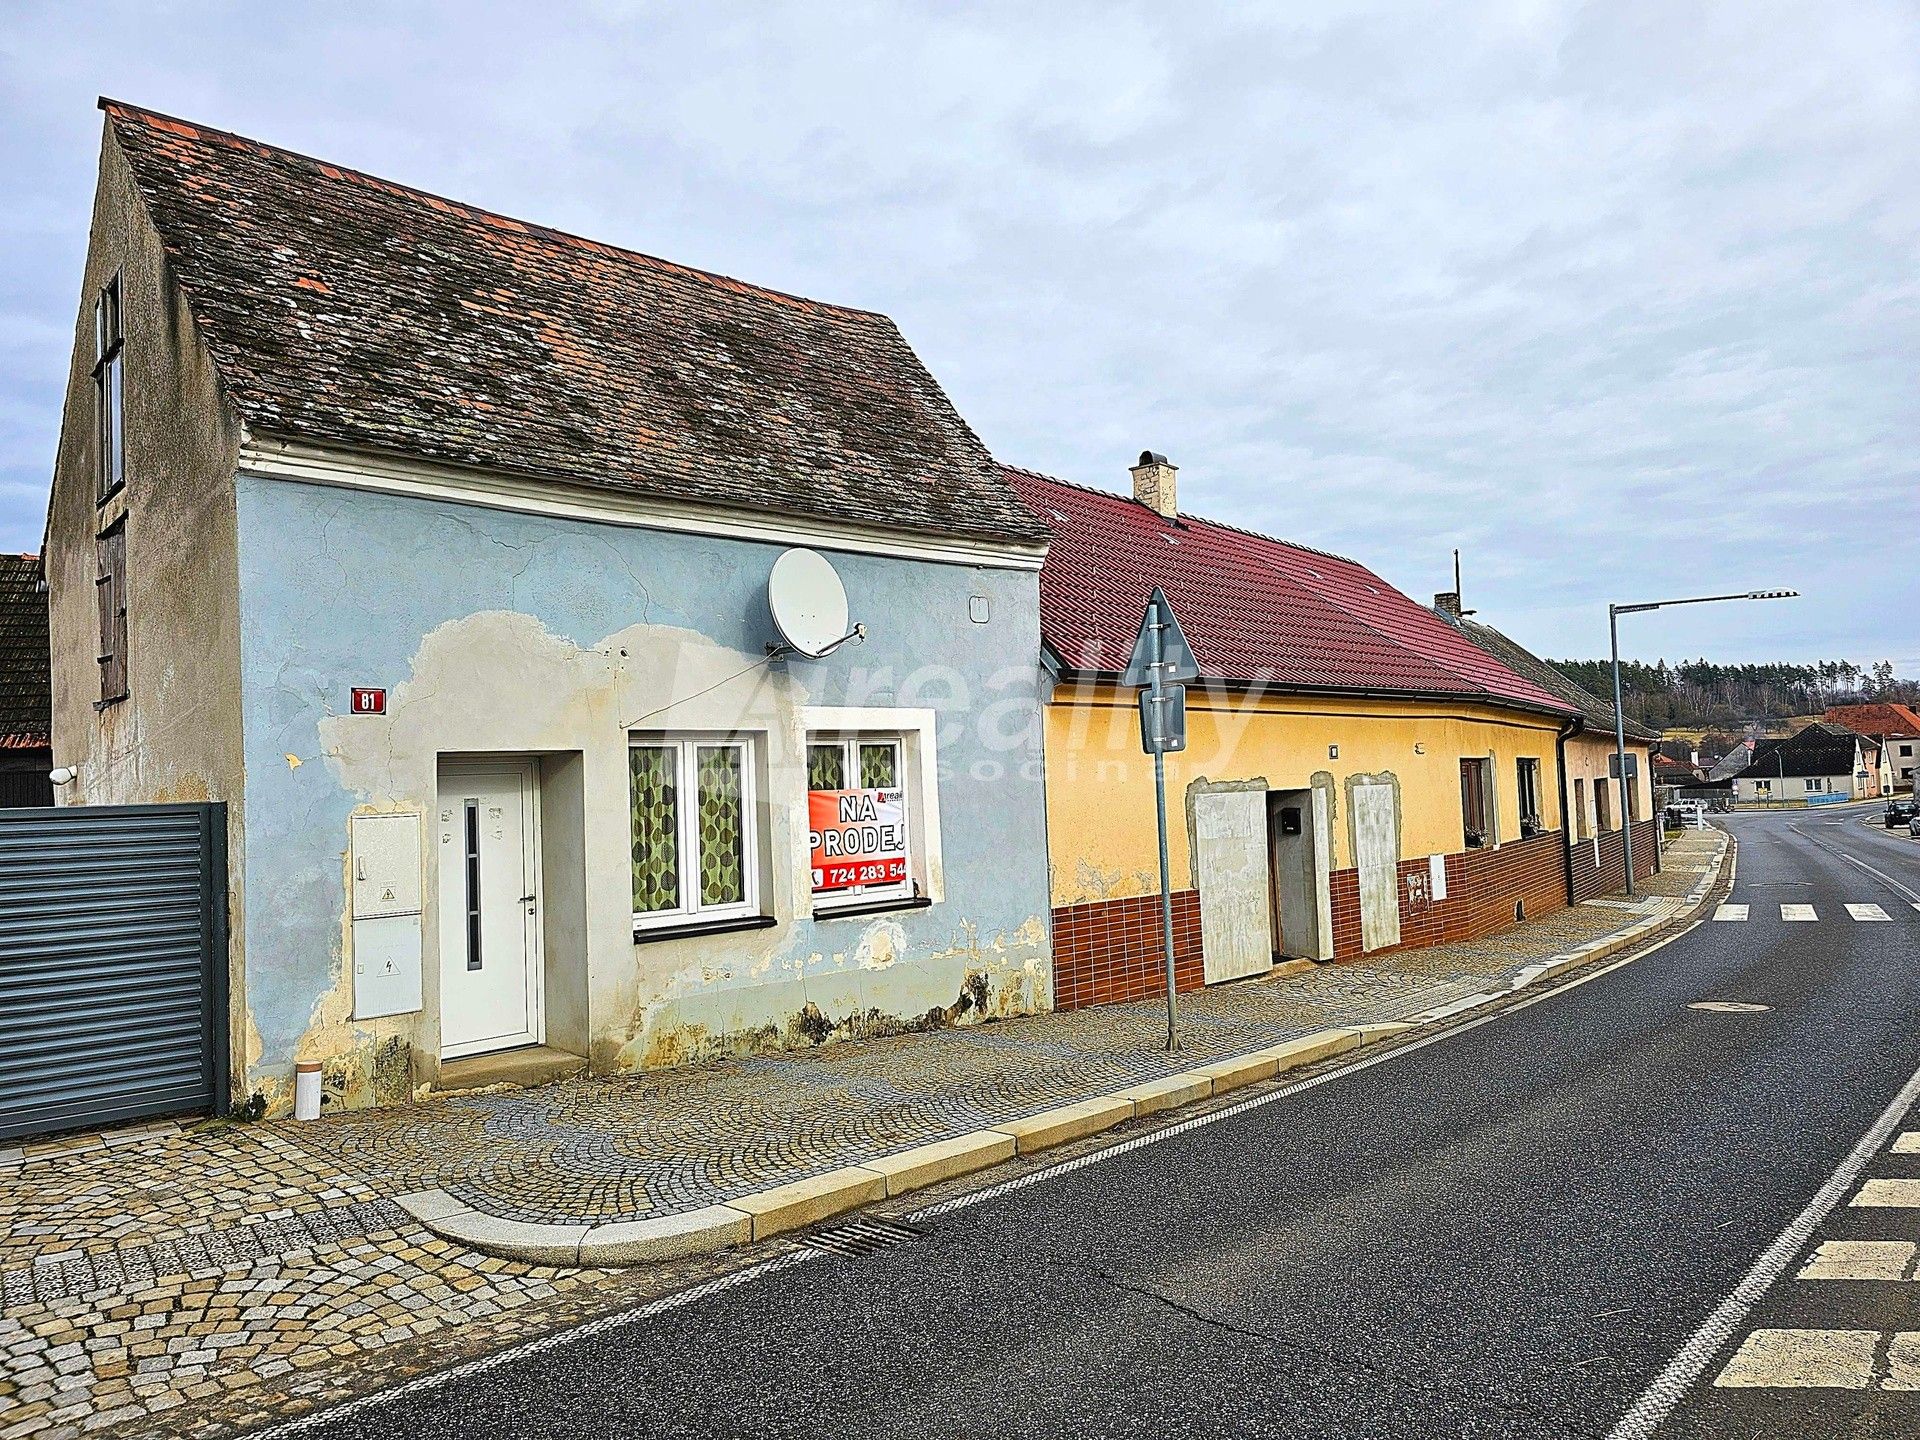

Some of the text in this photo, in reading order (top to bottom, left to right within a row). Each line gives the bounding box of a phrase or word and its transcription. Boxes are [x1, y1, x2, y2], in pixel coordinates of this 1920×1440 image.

[361, 693, 375, 710] 81
[839, 795, 877, 823] NA
[810, 824, 905, 857] PRODEJ
[830, 863, 906, 883] 724 283 54
